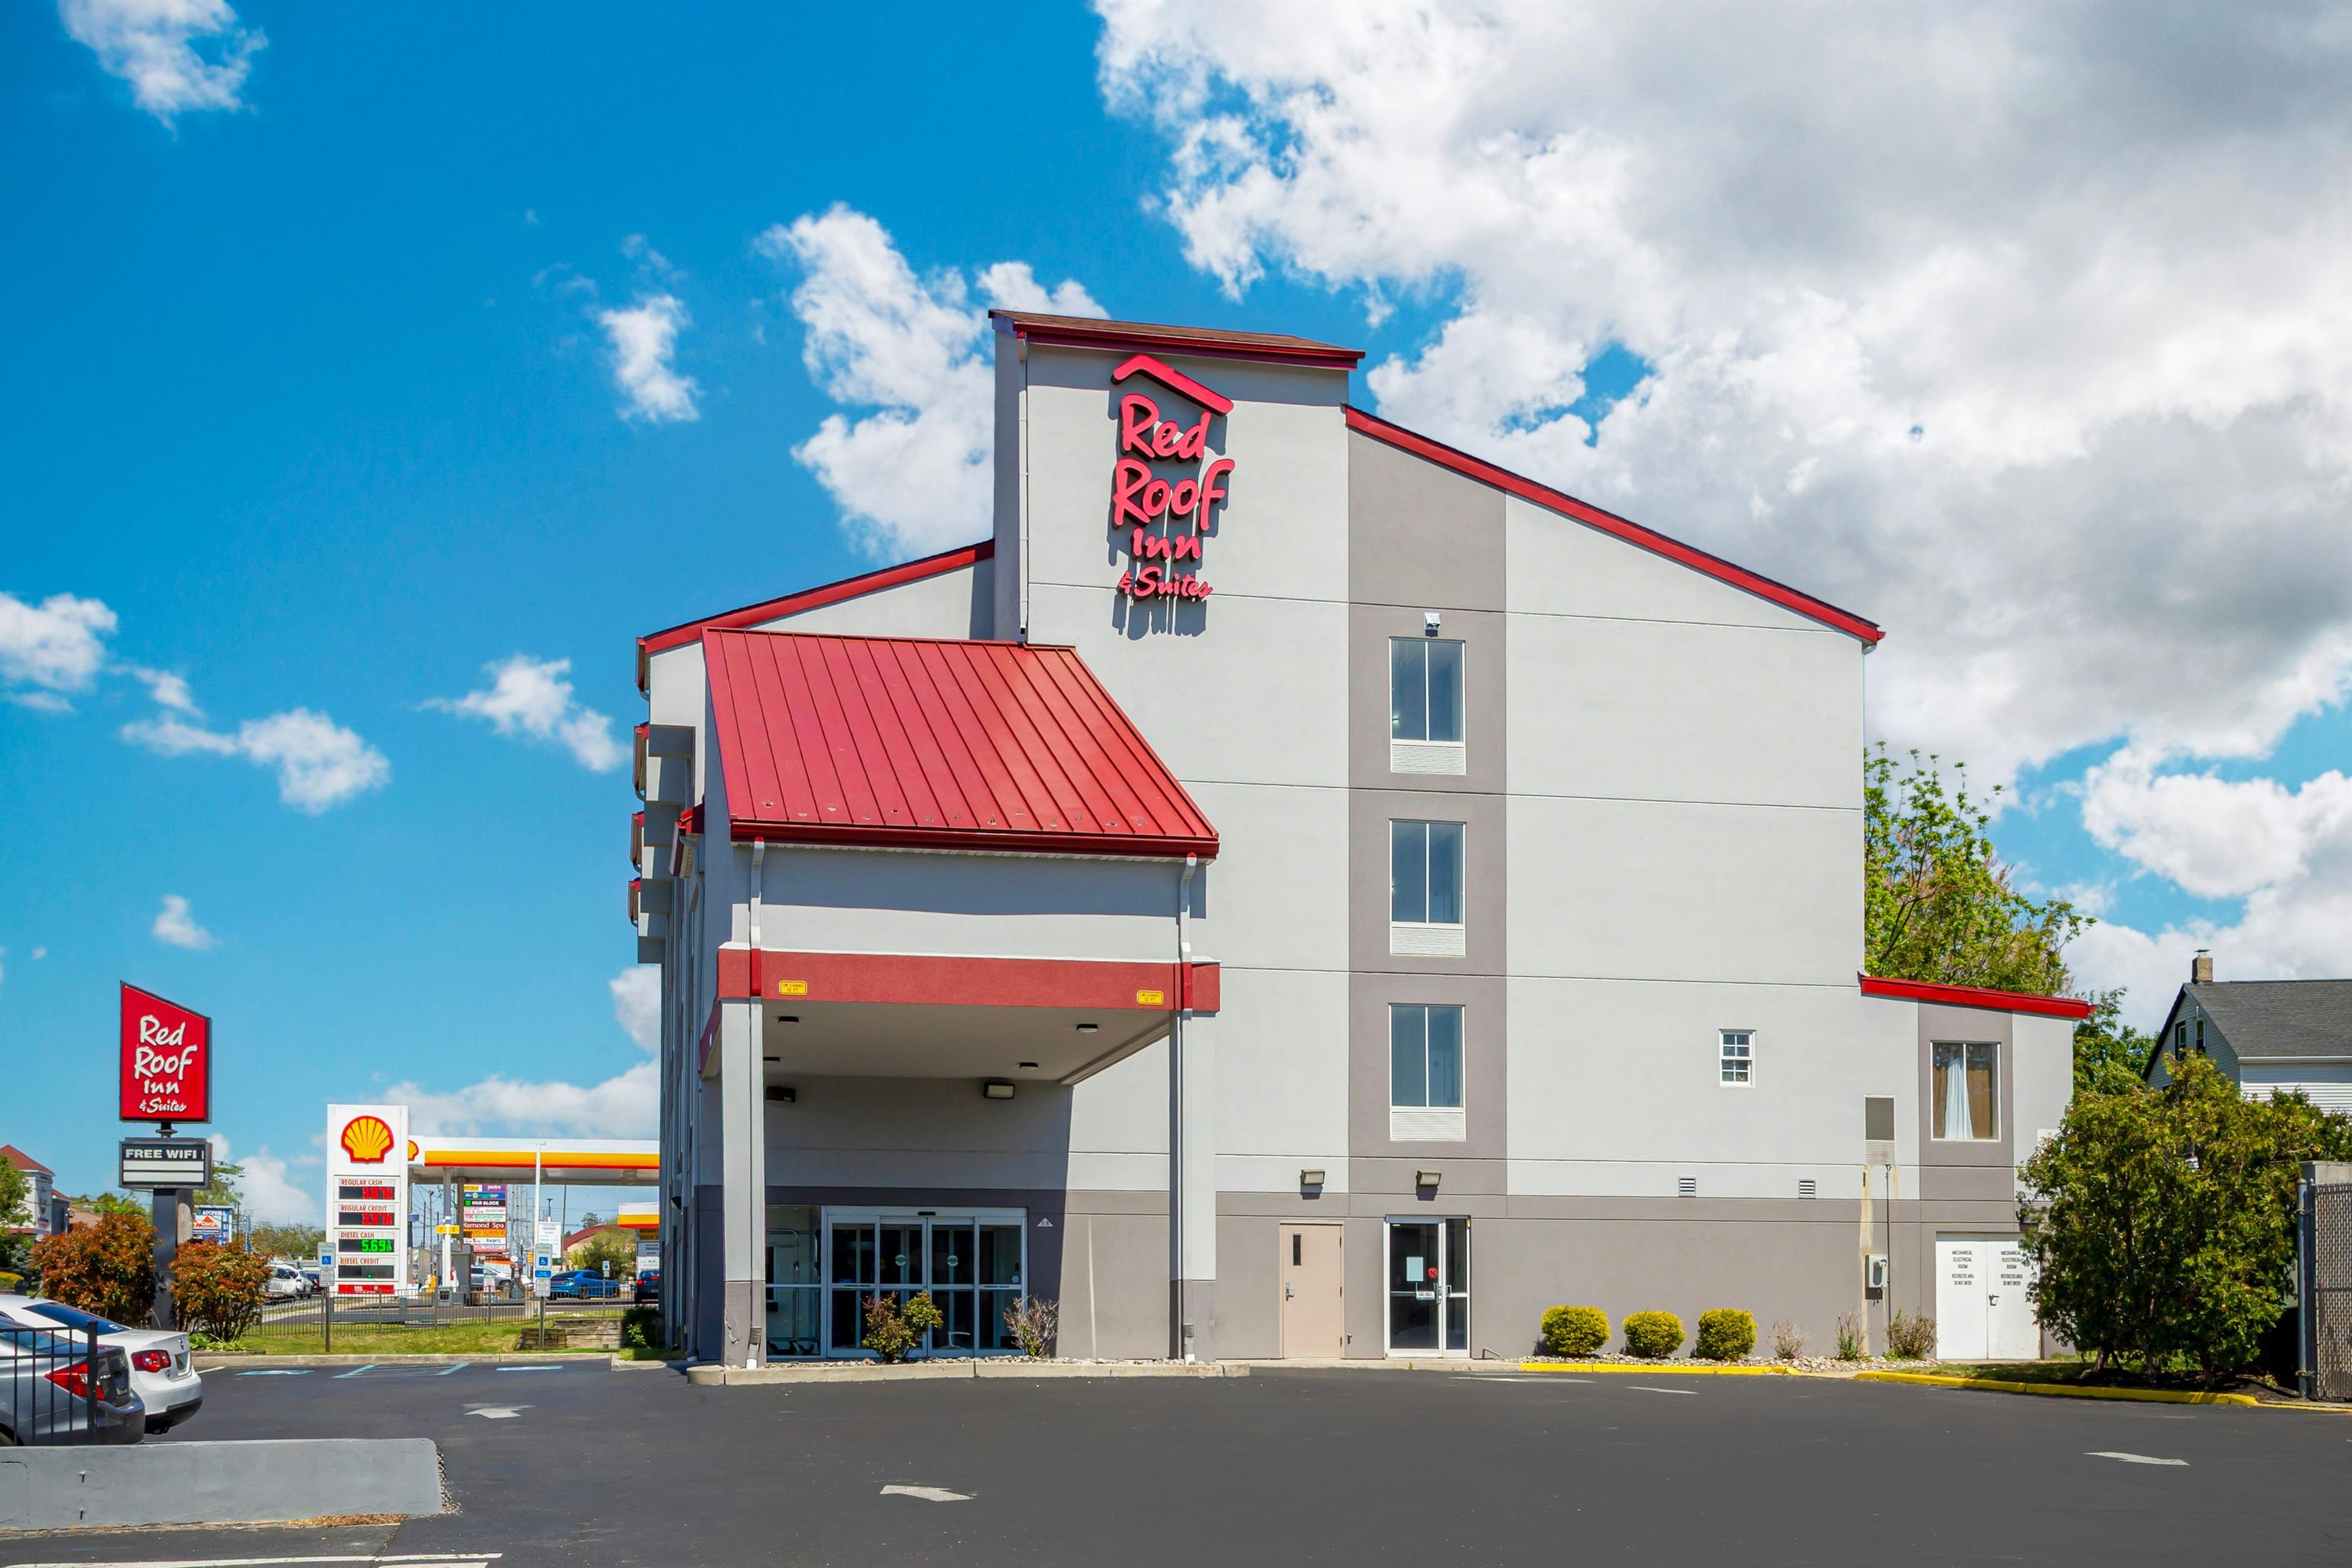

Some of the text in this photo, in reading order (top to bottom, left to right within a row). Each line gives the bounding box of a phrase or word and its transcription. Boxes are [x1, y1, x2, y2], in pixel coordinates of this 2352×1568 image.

[1120, 394, 1211, 459] Red
[1112, 458, 1236, 532] Roof
[1133, 527, 1202, 560] Inn
[140, 1014, 186, 1046] Red
[134, 1044, 198, 1080] Roof
[143, 1079, 180, 1094] Inn
[125, 1149, 197, 1159] FREE WIFI
